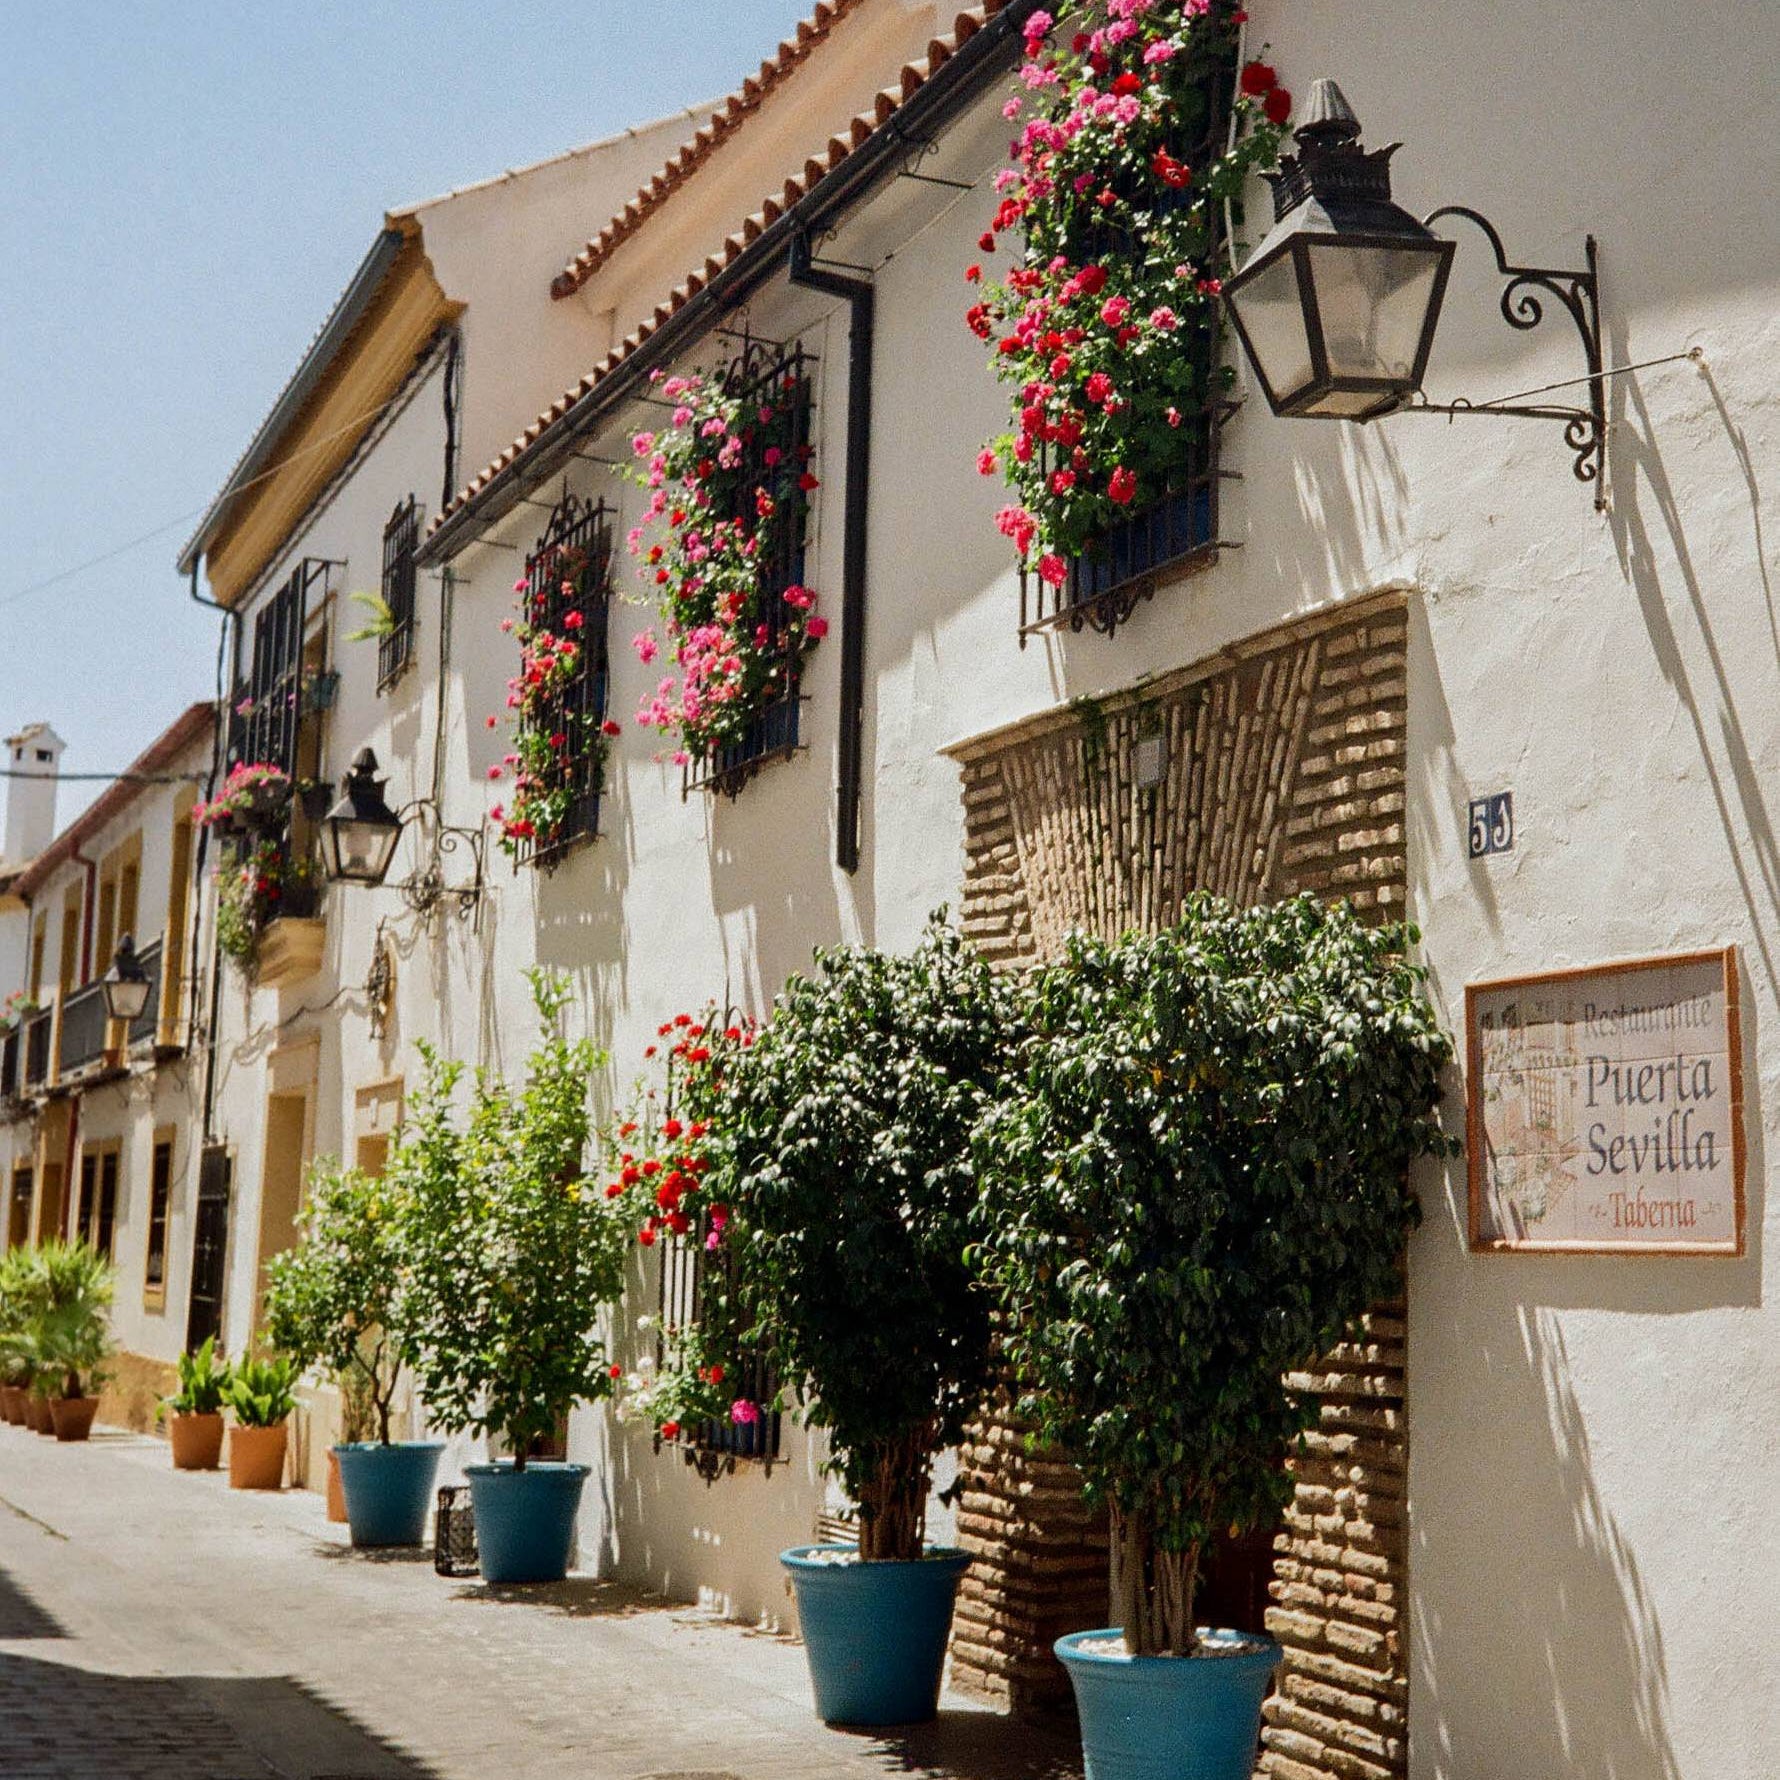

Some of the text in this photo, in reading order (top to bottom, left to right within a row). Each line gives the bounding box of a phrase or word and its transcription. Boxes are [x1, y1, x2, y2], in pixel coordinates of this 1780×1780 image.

[1583, 996, 1713, 1039] Restaurante
[1585, 1054, 1718, 1108] Puerta
[1587, 1108, 1721, 1175] Sevilla
[1609, 1185, 1697, 1229] Taberna
